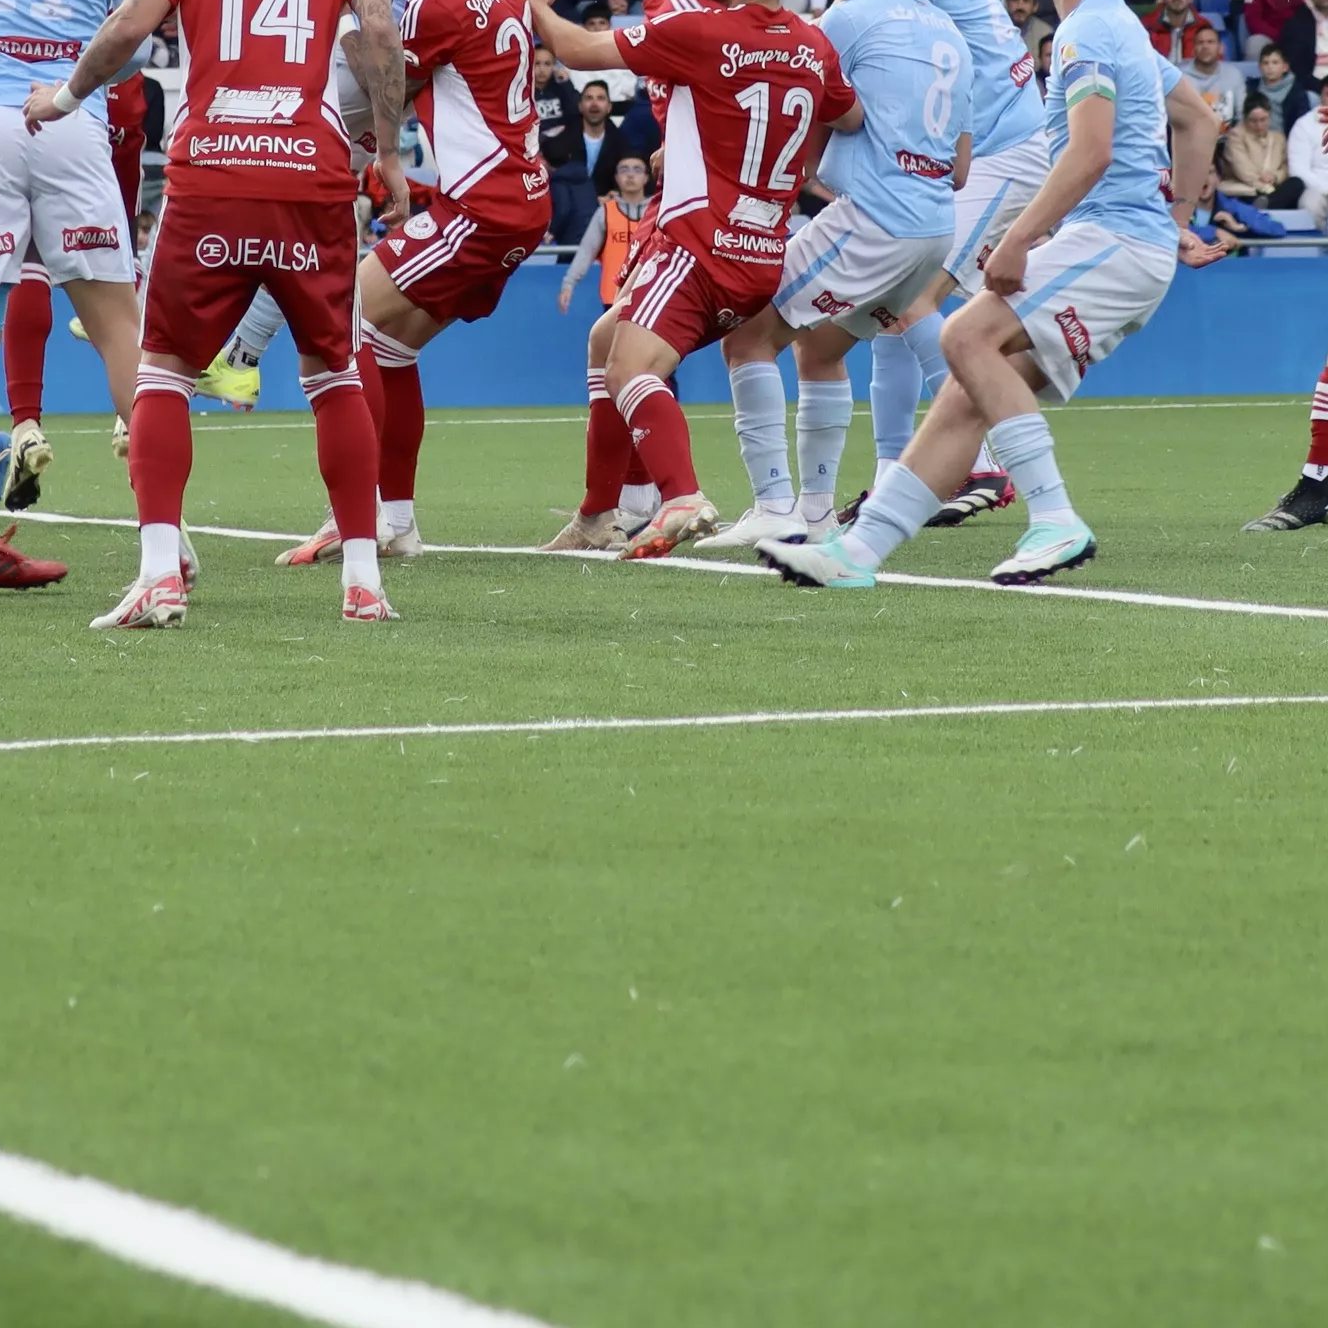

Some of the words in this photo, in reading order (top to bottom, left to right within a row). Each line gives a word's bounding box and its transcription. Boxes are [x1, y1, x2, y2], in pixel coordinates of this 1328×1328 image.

[719, 42, 791, 78] Siempre
[214, 86, 301, 102] Torralva
[923, 40, 960, 139] 8
[211, 134, 317, 157] JIMANG
[734, 81, 814, 191] 12
[220, 157, 265, 167] Aplicadora
[265, 159, 317, 172] Homologada
[229, 237, 320, 272] JEALSA
[733, 233, 784, 254] JIMANG
[769, 468, 778, 478] 8
[817, 463, 826, 475] 8
